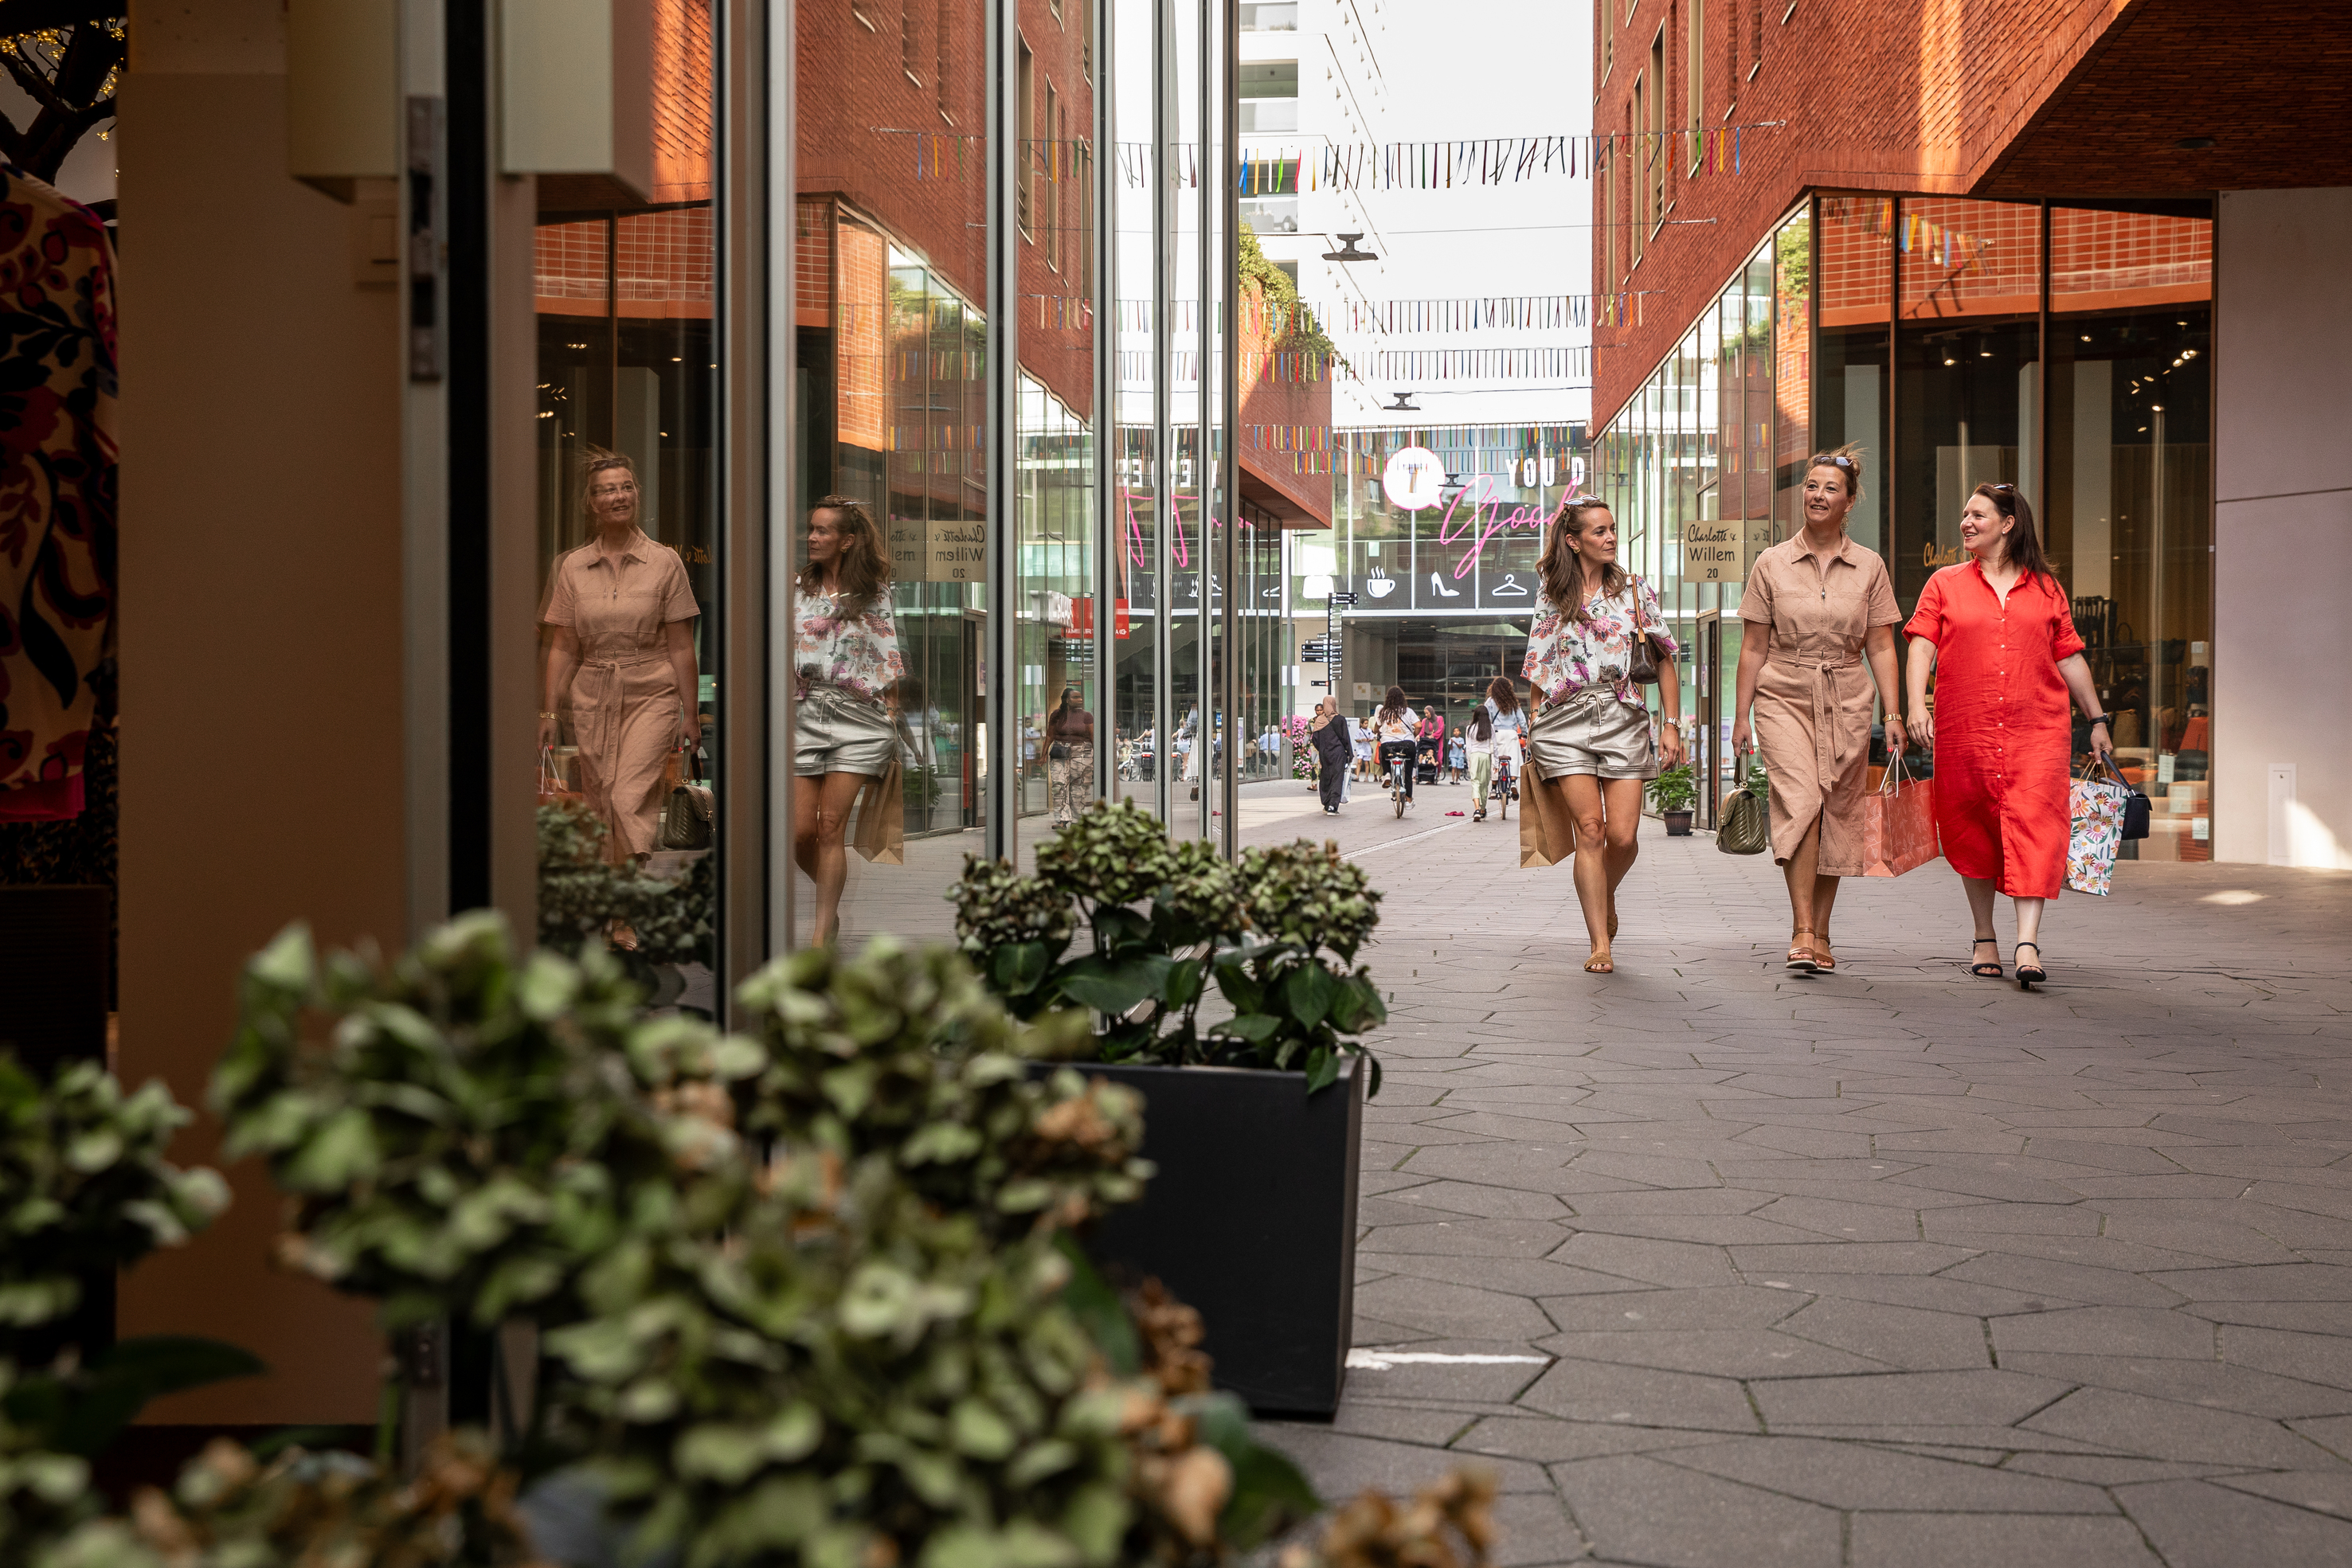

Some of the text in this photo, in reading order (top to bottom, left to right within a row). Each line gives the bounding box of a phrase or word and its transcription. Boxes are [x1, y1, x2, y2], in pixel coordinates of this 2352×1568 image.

[1505, 456, 1556, 488] YOU
[1689, 523, 1730, 542] Charlotte
[1689, 546, 1736, 561] Willem
[1707, 568, 1719, 579] 20
